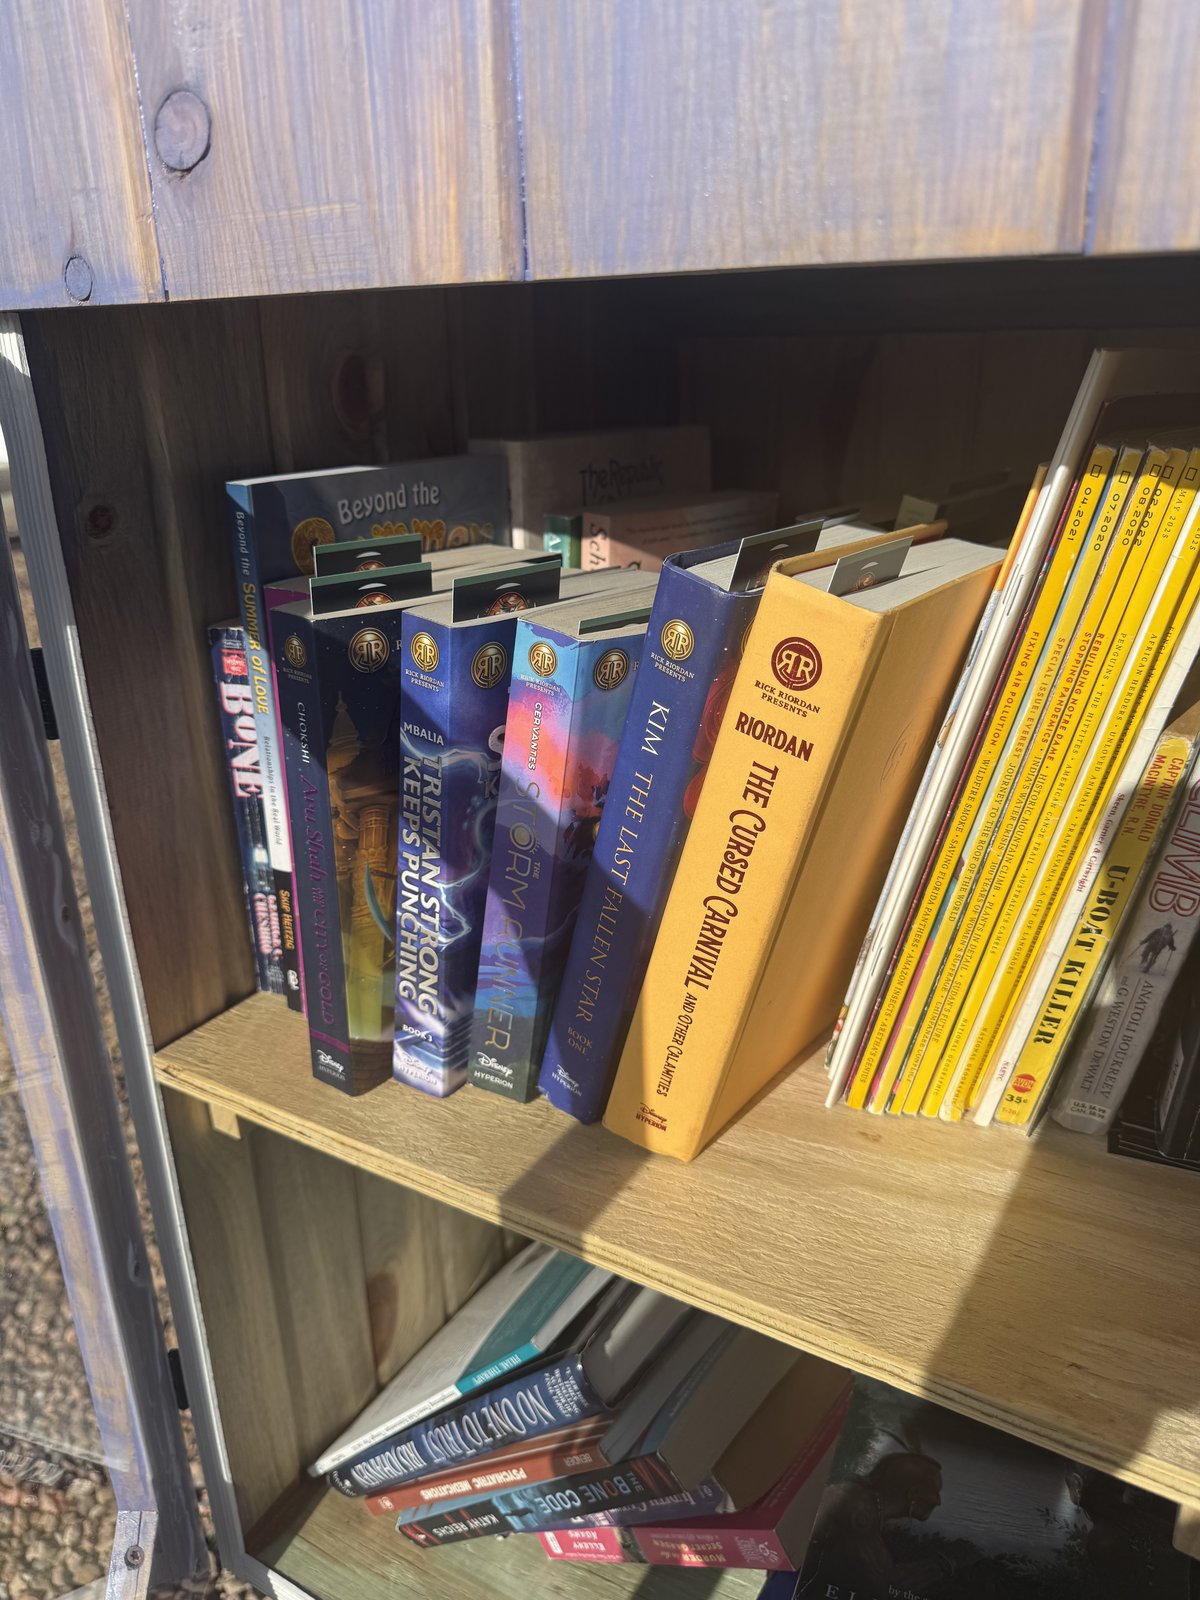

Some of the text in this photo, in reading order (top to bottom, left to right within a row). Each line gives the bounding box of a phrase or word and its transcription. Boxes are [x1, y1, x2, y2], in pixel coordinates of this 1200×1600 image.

[337, 481, 440, 525] Beyond the
[1067, 486, 1092, 541] 04.2021
[1092, 492, 1120, 552] 07.2020
[1121, 485, 1150, 546] 08.2020
[1133, 486, 1162, 547] 02.2022
[1161, 489, 1186, 539] MAY 2025
[234, 510, 270, 714] Beyond the SUMMER of LOVE
[650, 652, 694, 679] RICK RIORDAN
[654, 663, 686, 682] PRESENTS
[1065, 631, 1091, 684] STOPPING
[1102, 632, 1126, 680] PENGUINS
[1134, 633, 1157, 675] AFRICAN
[404, 668, 444, 688] RICK RIORDAN
[411, 680, 440, 692] PRESENTS
[754, 680, 820, 714] RICK RIORDAN
[1090, 690, 1102, 709] THE
[1115, 678, 1138, 721] HERDERS
[761, 693, 807, 718] PRESENTS
[1040, 685, 1069, 743] PANDEMICS
[292, 701, 314, 764] CHOKSHI
[401, 721, 447, 745] MBALIA
[525, 701, 544, 770] CERVANTES
[735, 712, 814, 762] RIORDAN
[1071, 711, 1093, 754] HITTITES
[1093, 730, 1115, 772] UNLOVED
[947, 636, 1065, 922] SPECIAL ISSUE: EVEREST JOURNEY TO THE ROOF OF THE WORLD
[1023, 755, 1041, 787] INDIA'S
[1049, 763, 1072, 808] AMERICAN
[300, 773, 322, 824] Aru
[1008, 786, 1028, 821] WATER
[1076, 774, 1096, 813] ANIMALS
[1107, 792, 1125, 819] Skeen,
[1120, 751, 1168, 839] MACINTYRE, R.N.
[1135, 755, 1185, 843] CAPTAIN DONALD
[304, 824, 328, 881] Shah
[858, 630, 1039, 1083] FIXING AIR POLLUTION WILDFIRE SMOKE SAVING FLORIDA PANTHERS AMAZON INSECTS ARETHA'S GENIUS
[931, 632, 1104, 1043] REBUILDING NOTRE DAME HISTORIC MOUNTAIN CLIMB PLANTS IN DETAIL SUDAN'S FUTURE
[997, 822, 1013, 851] CRISIS
[1025, 840, 1040, 865] TRAIL
[1045, 822, 1076, 883] TRANSYLVANIA
[397, 756, 420, 999] KEEPS PUNCHING
[531, 861, 541, 879] THE
[573, 700, 671, 1022] KIM THE LAST FALLEN STAR
[987, 860, 998, 874] 100
[418, 756, 442, 1015] TRISTAN STRONG
[976, 873, 993, 903] YEARS
[1001, 873, 1027, 923] AUSTRALIA'S
[477, 777, 548, 1050] STORM RUNNER
[652, 758, 779, 1097] THE CURSED CARNIVAL AND OTHER CALAMITIES
[971, 903, 981, 915] OF
[1025, 919, 1034, 930] OF
[1030, 898, 1043, 918] CITY
[956, 916, 976, 953] WOMEN'S
[988, 924, 1005, 954] CAMELS
[1028, 858, 1132, 1049] U-BOAT KILLER
[940, 953, 961, 992] SUFFRAGE
[318, 971, 334, 1025] GOLD
[1096, 985, 1128, 1048] G. WESTON
[401, 1022, 426, 1039] BOOK
[564, 1025, 595, 1049] BOOK
[918, 1000, 942, 1048] CHIMPANZEE
[1098, 980, 1154, 1098] ANATOLI BOUKREEV
[473, 1066, 513, 1091] HYPERION
[476, 1052, 514, 1078] Disney
[1013, 1078, 1033, 1089] AVON
[471, 1353, 521, 1386] FILIAL THERAPY
[458, 1408, 492, 1449] TO
[480, 1394, 526, 1445] ONE
[512, 1382, 556, 1432] NO
[395, 1438, 426, 1474] IRIS
[421, 1417, 473, 1467] TRUST
[348, 1445, 406, 1492] JOHANSEN
[419, 1465, 527, 1501] PSYCHIATRIC MEDICATIONS
[578, 1471, 631, 1507] BONE
[533, 1484, 582, 1519] CODE
[431, 1510, 499, 1541] KATHY REICHS
